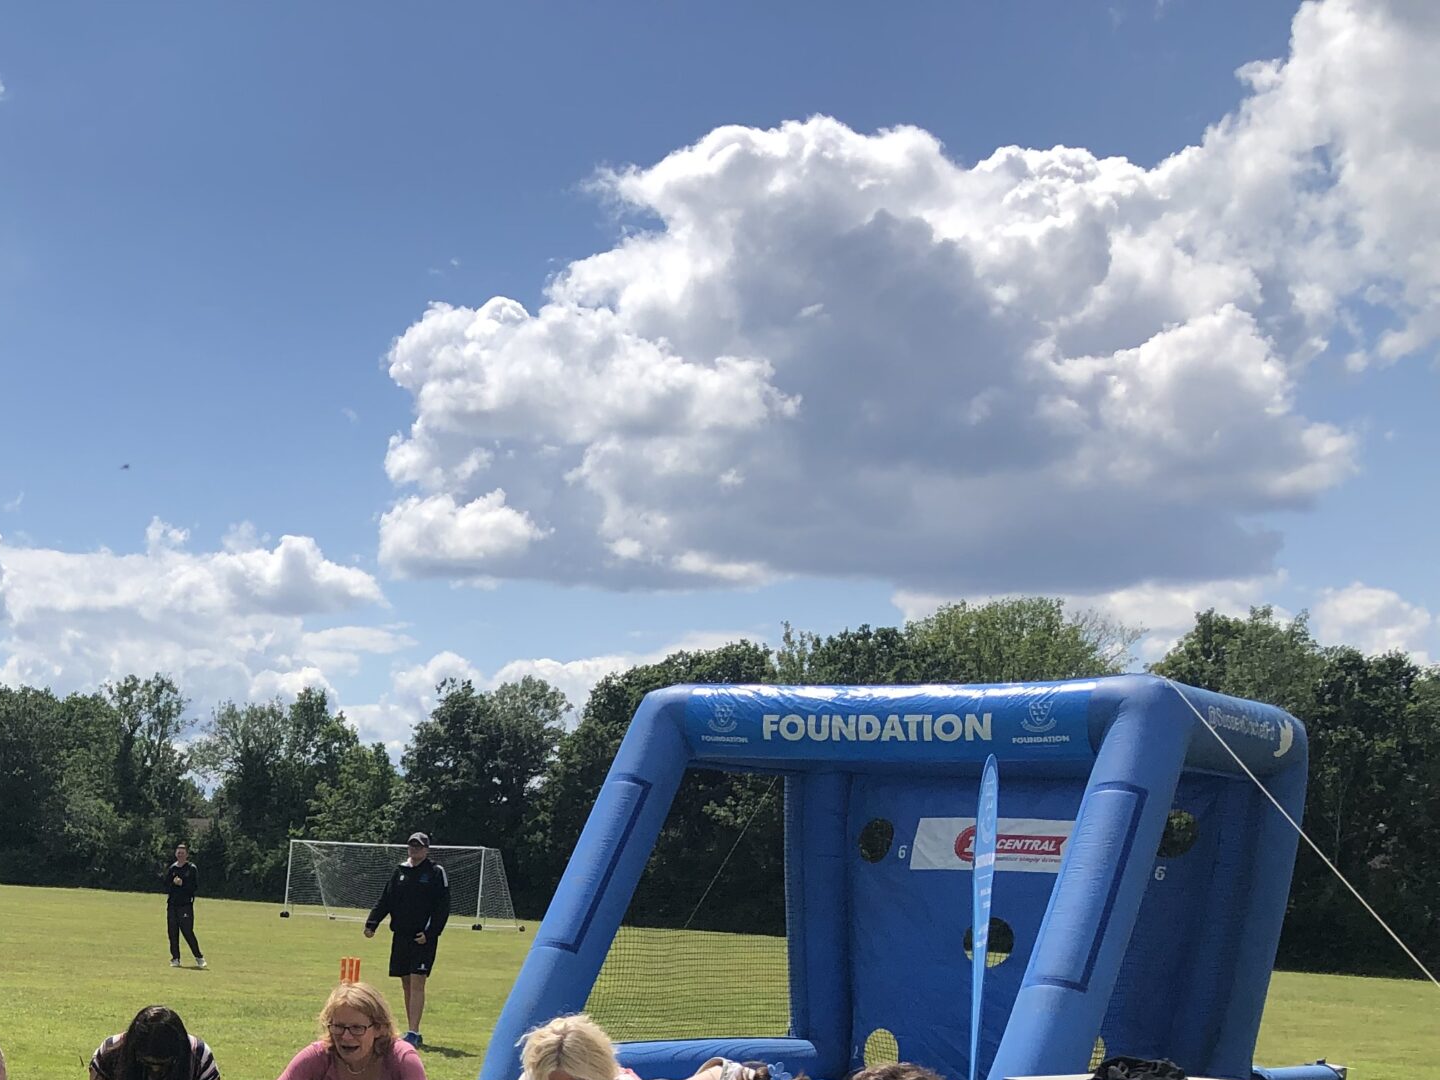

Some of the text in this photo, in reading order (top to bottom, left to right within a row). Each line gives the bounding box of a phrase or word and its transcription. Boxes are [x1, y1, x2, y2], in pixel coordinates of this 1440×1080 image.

[762, 712, 993, 742] FOUNDATION
[1011, 735, 1070, 745] FOUNDATION
[898, 845, 908, 859] 6
[995, 838, 1058, 852] CENTRAL
[1154, 865, 1167, 881] 6
